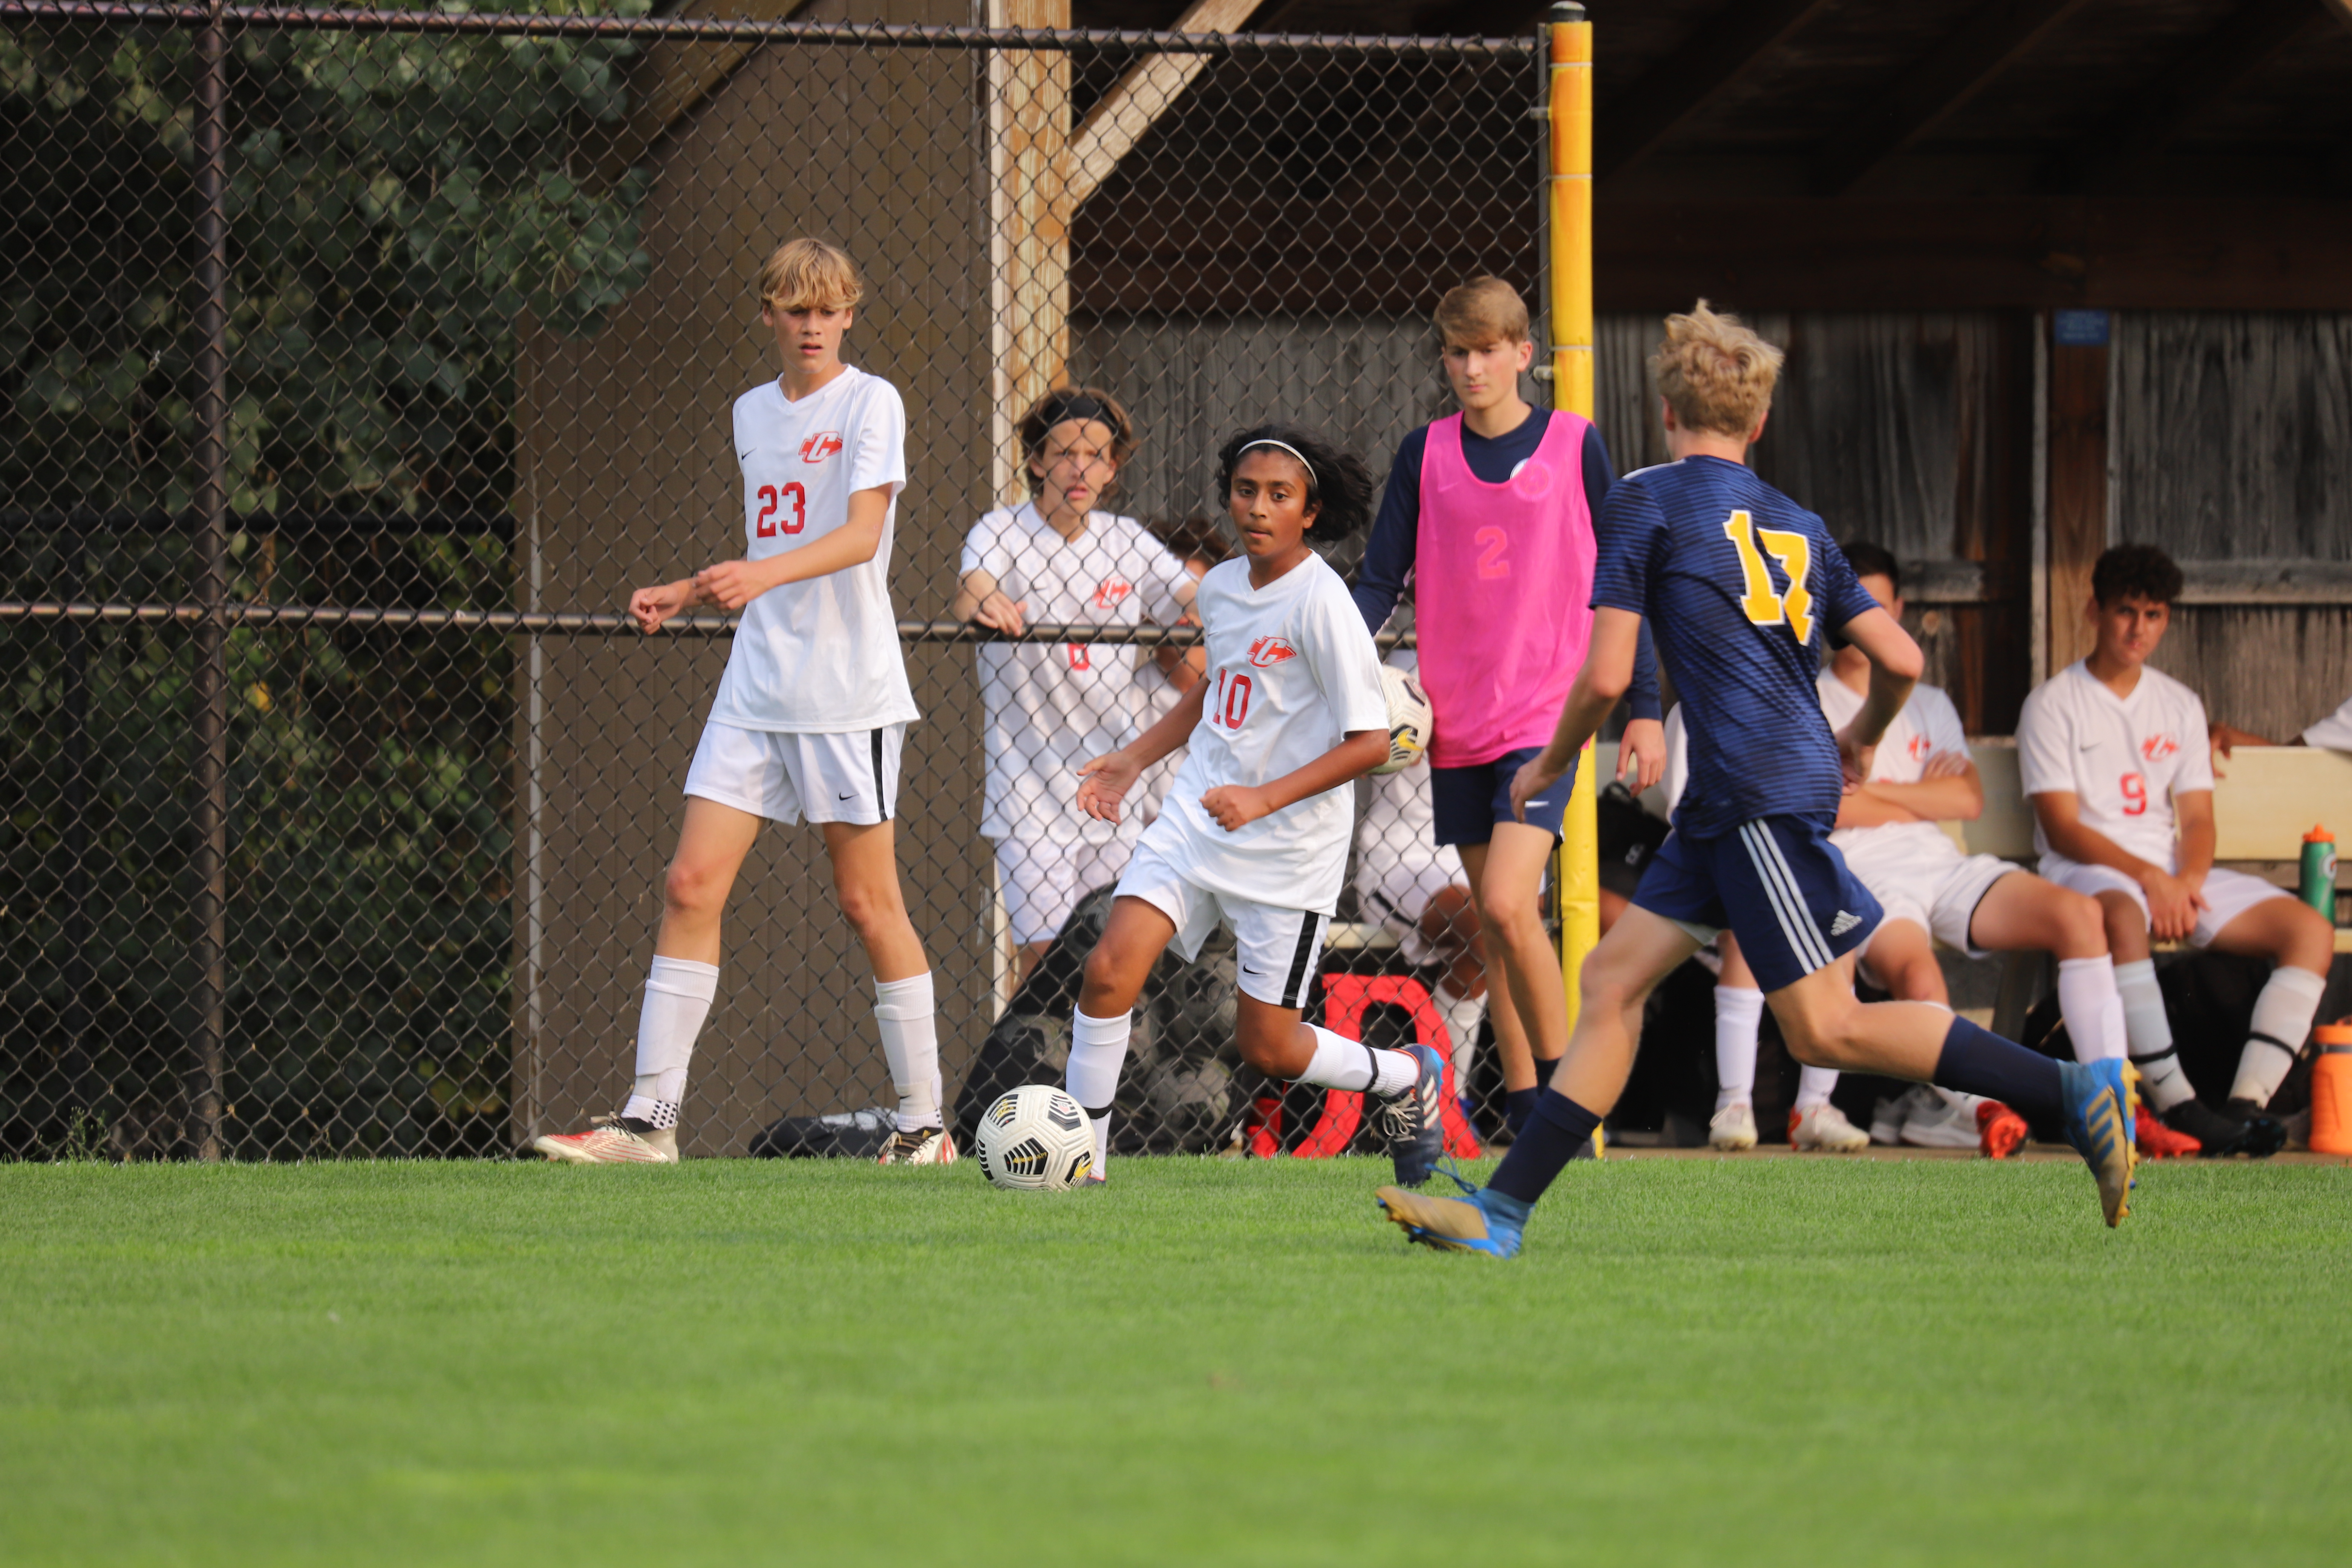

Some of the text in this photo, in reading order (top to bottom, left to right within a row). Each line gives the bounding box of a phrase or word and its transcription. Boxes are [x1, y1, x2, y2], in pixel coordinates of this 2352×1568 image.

[802, 431, 840, 463] C
[757, 481, 805, 538] 23
[1474, 525, 1510, 580] 2
[1722, 509, 1815, 646] 17
[1250, 636, 1289, 668] C
[1213, 668, 1252, 729] 10
[2119, 772, 2147, 816] 9
